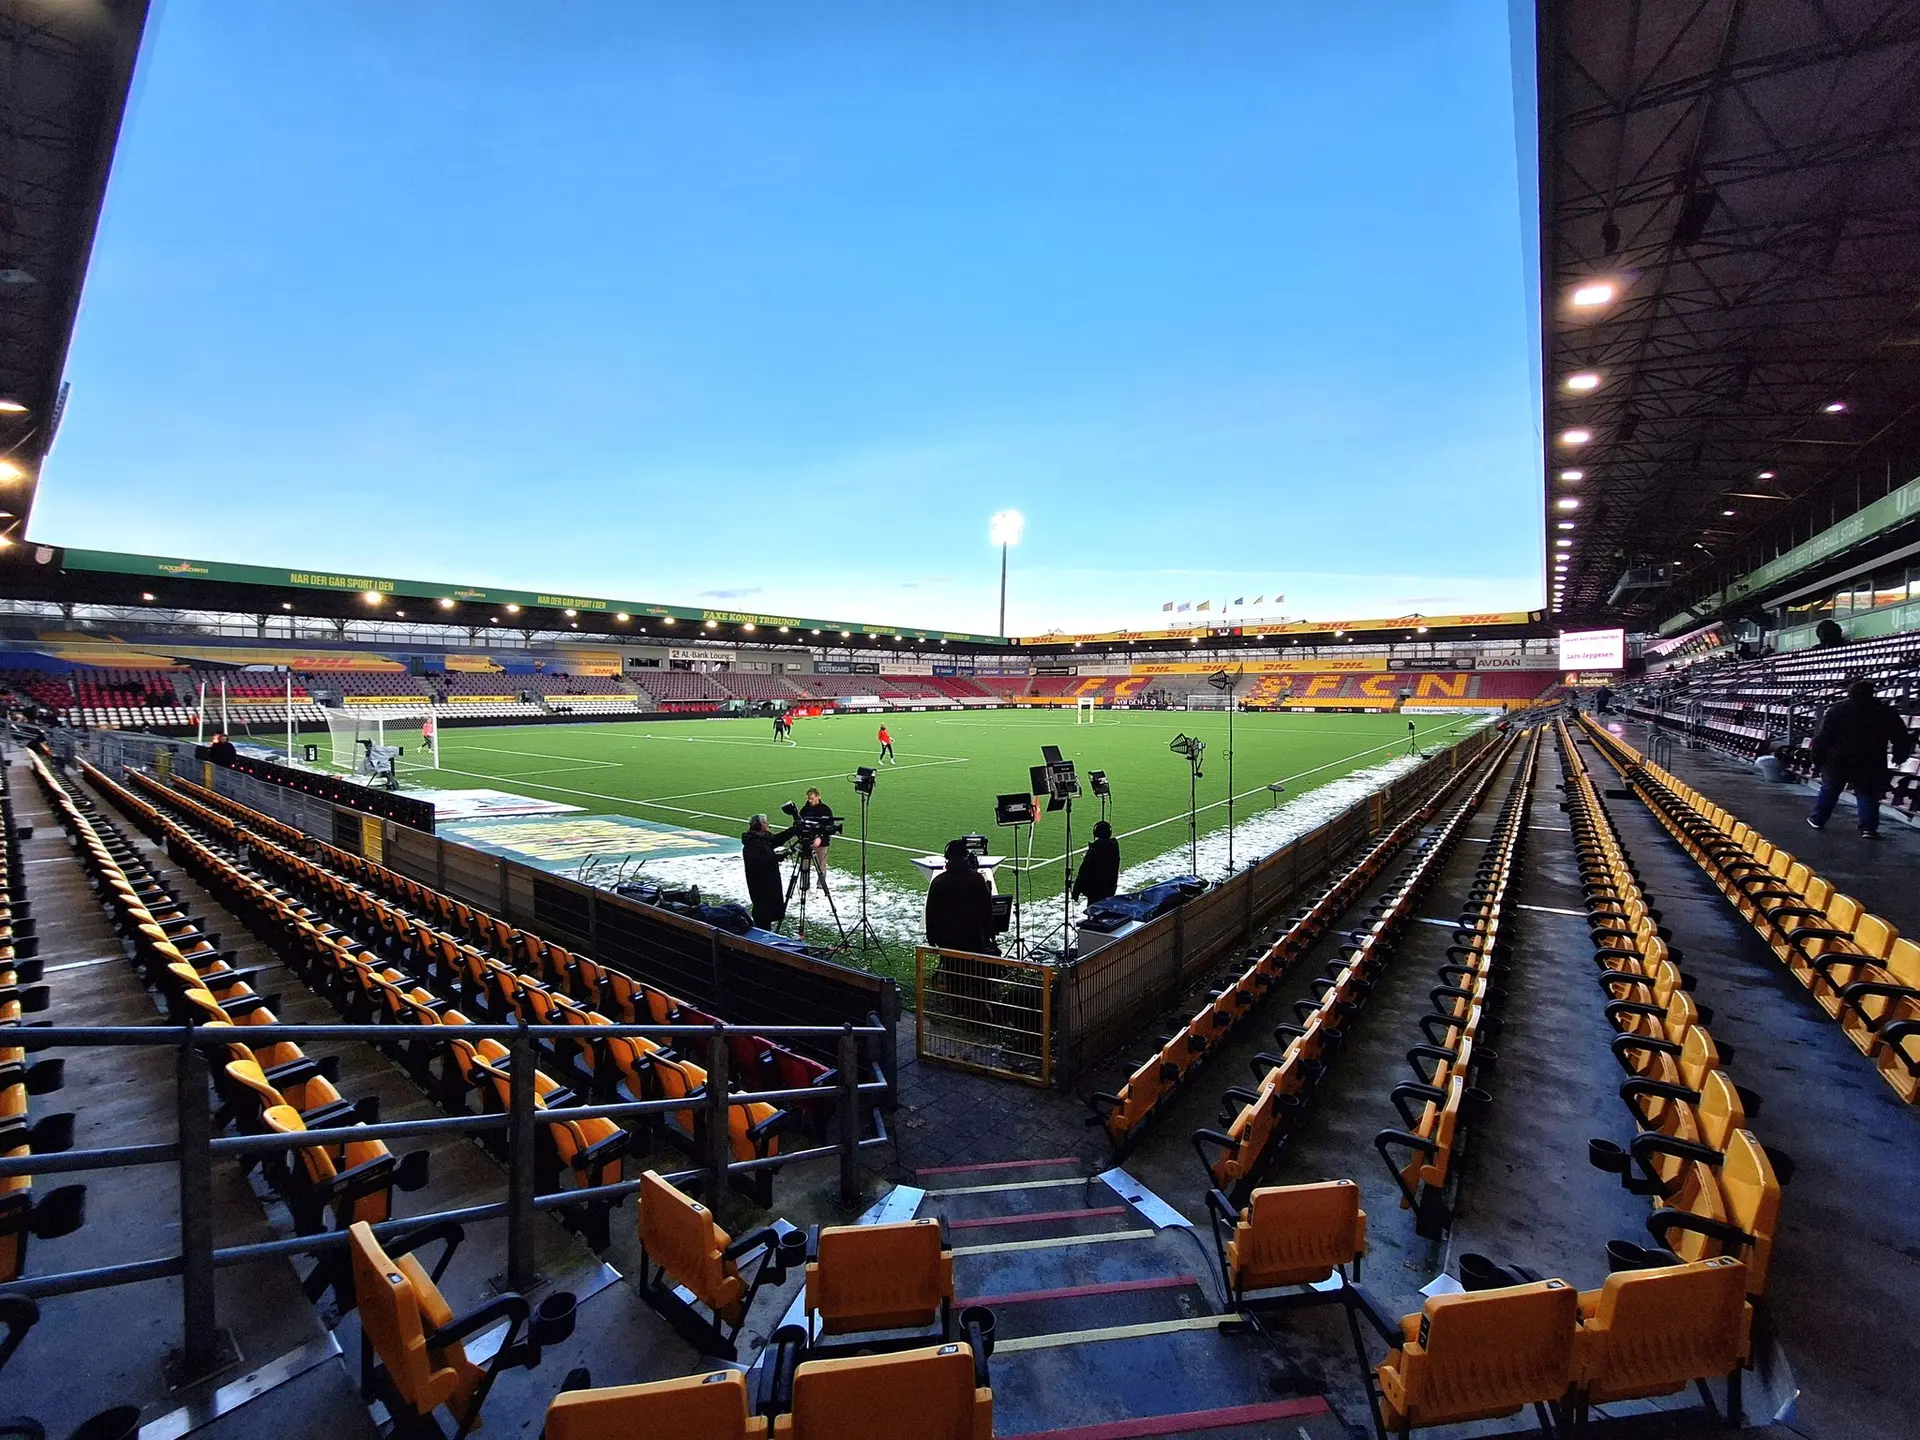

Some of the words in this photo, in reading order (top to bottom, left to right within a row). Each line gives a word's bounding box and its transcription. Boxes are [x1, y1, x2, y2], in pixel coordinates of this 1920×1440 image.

[1841, 518, 1865, 541] STORE
[310, 575, 328, 586] DER
[346, 578, 373, 590] SPORT
[378, 581, 394, 591] DEN
[703, 610, 728, 621] FAXE
[729, 613, 758, 623] KONDI
[758, 616, 801, 627] TRIBUNEN
[1384, 617, 1424, 628] DHL
[1459, 614, 1504, 624] DHL
[1256, 625, 1288, 634] DHL
[1317, 621, 1354, 630] DHL
[1073, 634, 1098, 642] DHL
[1117, 632, 1145, 640] DHL
[1166, 630, 1194, 638] DHL
[1031, 636, 1055, 644] DHL
[1582, 652, 1615, 660] Jeppesen
[291, 655, 357, 668] DHL
[1476, 658, 1521, 668] AVDAN
[1201, 664, 1229, 672] DHL
[1263, 663, 1295, 671] DHL
[1579, 671, 1613, 679] Arbejdernes
